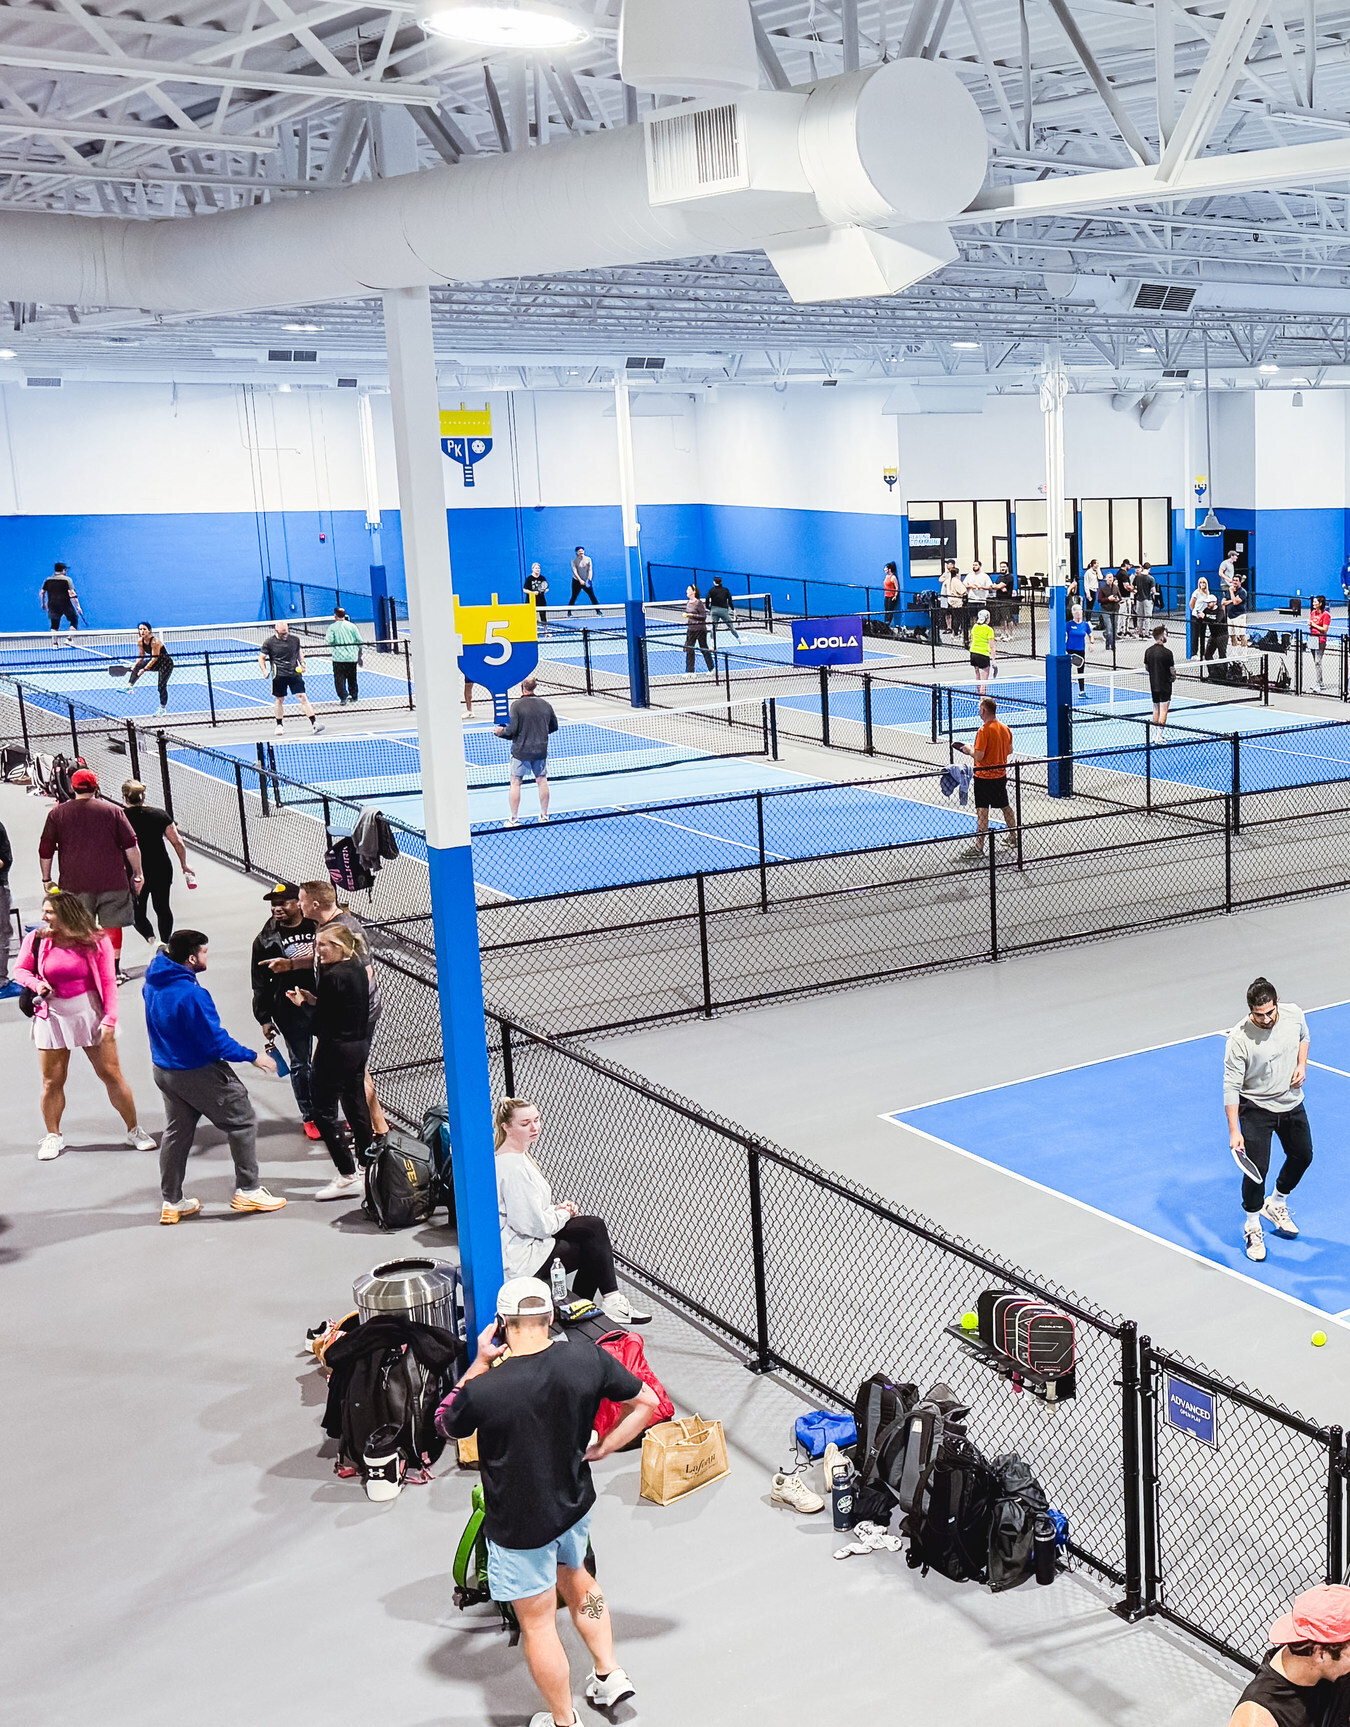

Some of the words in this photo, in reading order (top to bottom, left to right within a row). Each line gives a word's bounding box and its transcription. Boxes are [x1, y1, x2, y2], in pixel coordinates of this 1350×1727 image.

[447, 440, 462, 457] PK
[483, 620, 513, 666] 5
[809, 635, 859, 650] JOOLA
[342, 845, 355, 892] SELKIRK
[1170, 1394, 1211, 1420] ADVANCED
[1180, 1408, 1191, 1418] OPEN
[1191, 1414, 1201, 1423] PLAY
